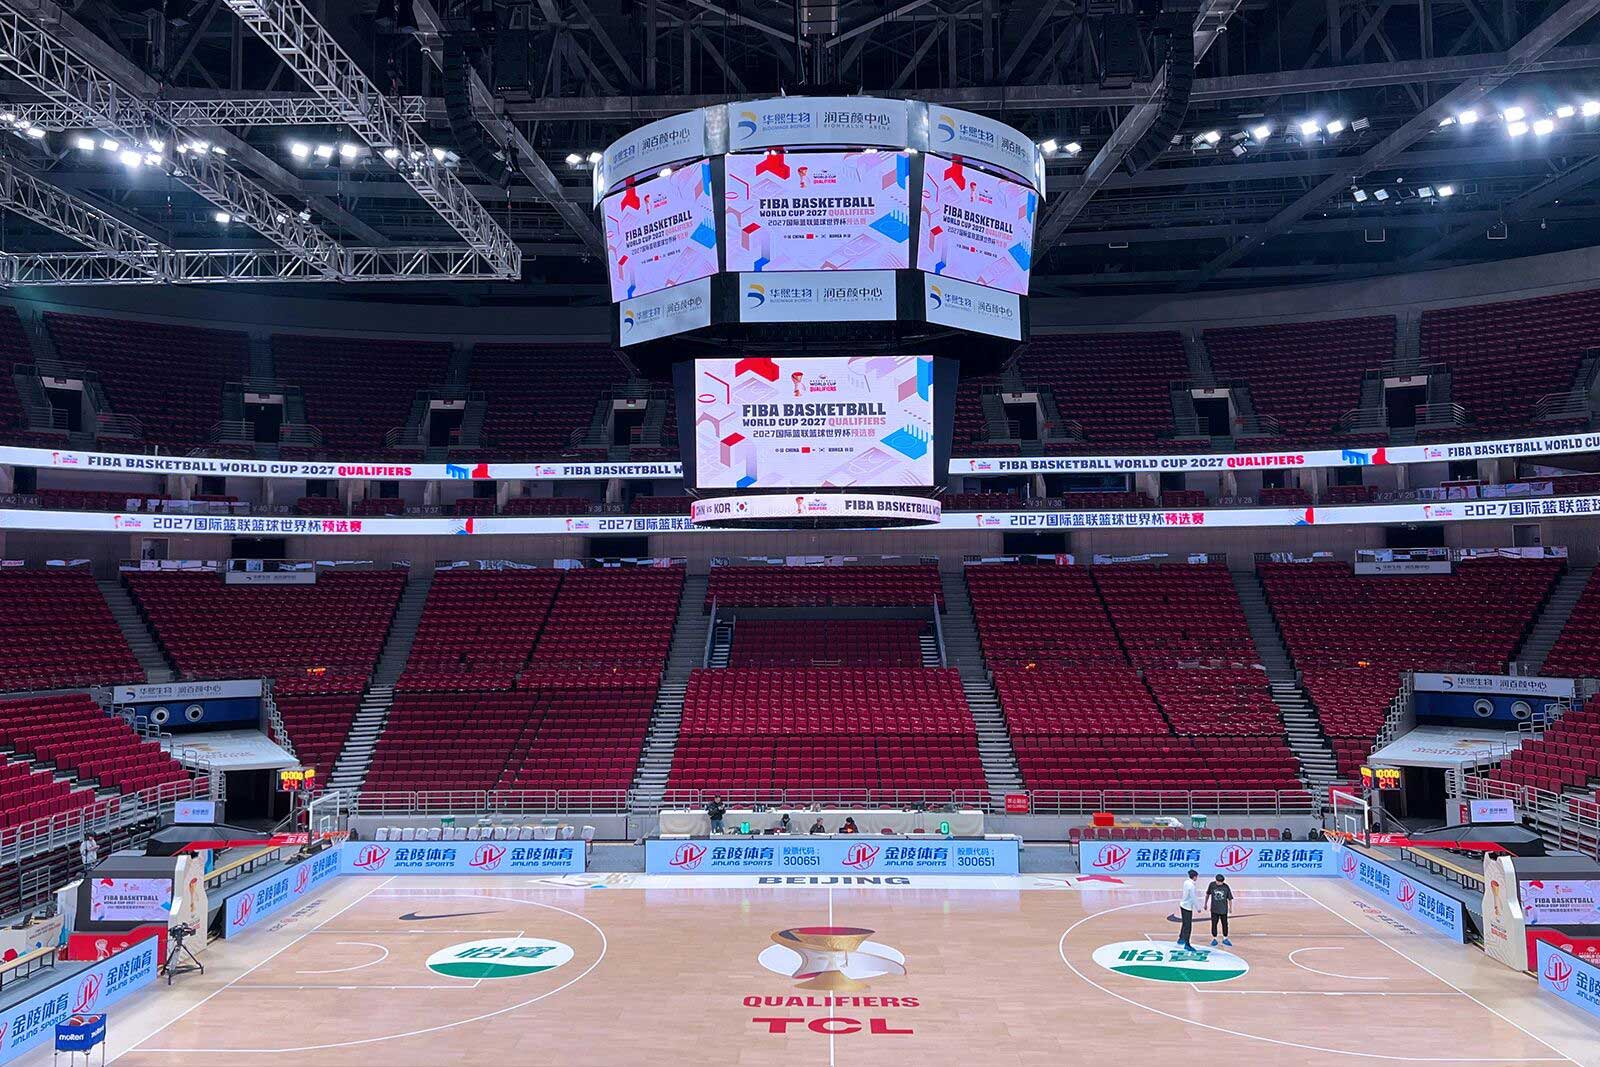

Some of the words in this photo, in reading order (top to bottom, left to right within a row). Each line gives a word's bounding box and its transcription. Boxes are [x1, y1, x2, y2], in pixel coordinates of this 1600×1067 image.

[762, 111, 810, 125] 华熙生物
[824, 111, 891, 126] 润百颜中心
[642, 128, 691, 151] 润百颜中心
[759, 198, 790, 209] FIBA
[792, 197, 876, 208] BASKETBALL
[759, 209, 787, 218] WORLD
[788, 209, 805, 217] CUP
[807, 209, 827, 217] 2027
[828, 208, 876, 216] QUALIFIERS
[943, 203, 963, 220] FIBA
[964, 210, 1014, 234] BASKETBALL
[625, 227, 643, 242] FIBA
[643, 210, 693, 237] BASKETBALL
[942, 215, 961, 227] WORLD
[960, 219, 972, 229] CUP
[626, 236, 642, 249] WORLD
[642, 233, 653, 244] CUP
[770, 287, 812, 299] 华熙生物
[823, 287, 883, 299] 润百颜中心
[742, 404, 780, 418] FIBA
[783, 402, 887, 417] BASKETBALL
[742, 418, 776, 428] WORLD
[778, 417, 799, 427] CUP
[800, 417, 827, 427] 2027
[828, 416, 887, 427] QUALIFIERS
[753, 428, 876, 438] 2027国际篮联篮球世界杯预选赛
[1447, 446, 1472, 458] FIBA
[1474, 441, 1543, 456] BASKETBALL
[1544, 438, 1583, 451] WORLD
[87, 455, 122, 468] FIBA
[125, 457, 217, 472] BASKETBALL
[220, 462, 267, 474] WORLD
[270, 464, 298, 475] CUP
[301, 465, 335, 475] 2027
[337, 465, 413, 477] QUALIFIERS
[999, 460, 1028, 470] FIBA
[1030, 459, 1112, 470] BASKETBALL
[1114, 458, 1158, 469] WORLD
[1161, 457, 1188, 469] CUP
[1190, 457, 1224, 468] 2027
[1226, 454, 1305, 468] QUALIFIERS
[563, 465, 591, 476] FIBA
[594, 464, 672, 476] BASKETBALL
[713, 502, 732, 514] KOR
[845, 499, 875, 511] FIBA
[876, 500, 933, 515] BASKETBALL
[153, 516, 362, 533] 2027国际篮联篮球世界杯预选赛
[1010, 511, 1205, 527] 2027国际篮联篮球世界杯预选赛
[282, 779, 298, 791] 24
[1379, 777, 1395, 789] 24
[393, 847, 457, 862] 金陵体育
[510, 847, 573, 862] 金陵体育
[711, 846, 774, 860] 金陵体育
[884, 846, 949, 860] 金陵体育
[1135, 848, 1201, 862] 金陵体育
[1258, 848, 1323, 862] 金陵体育
[783, 856, 820, 866] 300651
[957, 856, 995, 867] 300651
[1291, 861, 1323, 869] SPORTS
[758, 876, 911, 885] BEIJING
[1359, 861, 1390, 889] 金陵体育
[256, 877, 289, 908] 金陵体育
[1418, 891, 1455, 922] 金陵体育
[106, 949, 152, 988] 金陵体育
[105, 978, 129, 997] JINLING
[129, 967, 151, 986] SPORTS
[742, 996, 920, 1008] QUALIFIERS
[11, 991, 69, 1038] 金陵体育
[10, 1024, 39, 1049] JINLING
[40, 1011, 68, 1033] SPORTS
[752, 1017, 914, 1035] TCL
[58, 1033, 85, 1041] molten
